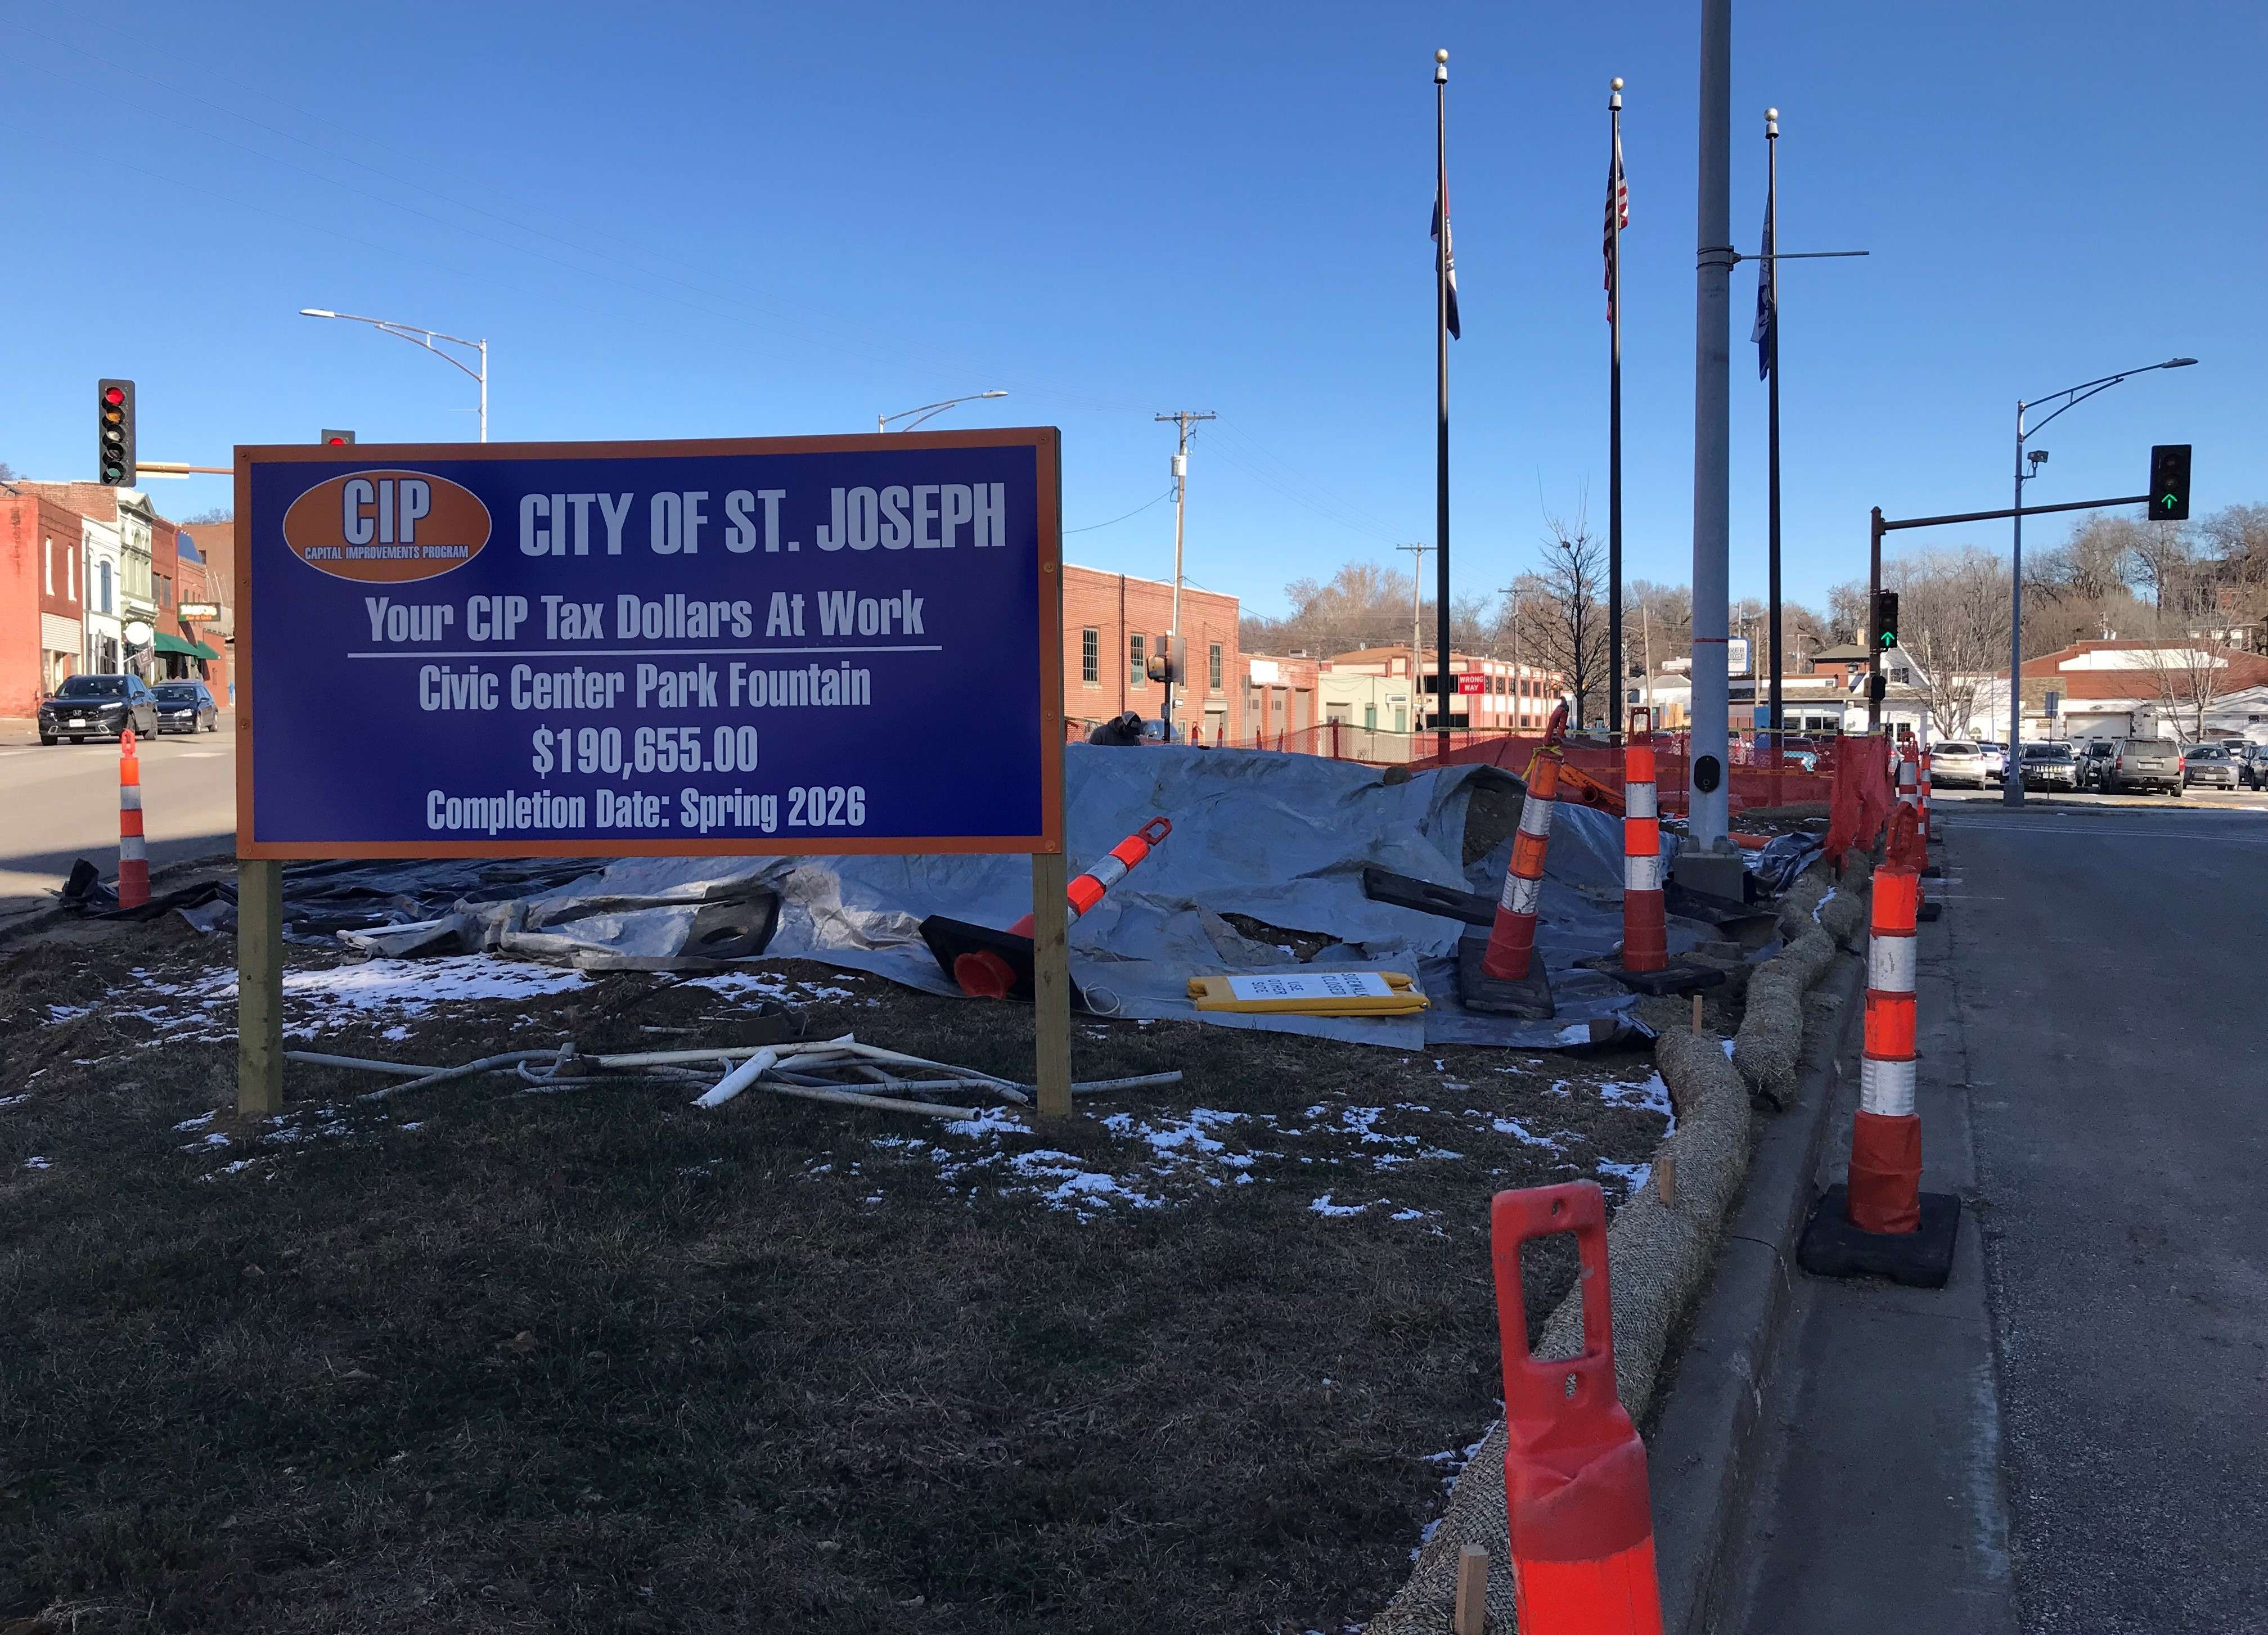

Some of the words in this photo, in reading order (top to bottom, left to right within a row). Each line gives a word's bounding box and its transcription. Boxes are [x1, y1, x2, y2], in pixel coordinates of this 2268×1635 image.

[344, 479, 430, 544] CIP
[520, 493, 634, 556] CITY
[651, 491, 709, 555] OF
[725, 489, 800, 553] ST.
[816, 483, 1006, 551] JOSEPH
[305, 547, 343, 560] CAPITAL
[345, 546, 420, 559] IMPROVEMENTS
[422, 546, 469, 558] PROGRAM
[365, 597, 454, 642] Your
[467, 595, 528, 641] CIP
[541, 595, 604, 640] Tax
[617, 593, 752, 639] Dollars
[766, 592, 805, 637] At
[817, 589, 925, 636] Work
[420, 665, 498, 711] Civic
[511, 664, 624, 710] Center
[637, 663, 718, 708] Park
[730, 660, 871, 707] Fountain
[532, 724, 758, 780] $190,655.00
[427, 790, 585, 835] Completion
[596, 789, 669, 828] Date:
[681, 787, 777, 834] Spring
[788, 786, 865, 826] 2026
[1252, 981, 1268, 993] SIDE
[1268, 979, 1288, 994] OTHER
[1288, 981, 1304, 991] USE
[1321, 976, 1347, 995] CLOSED
